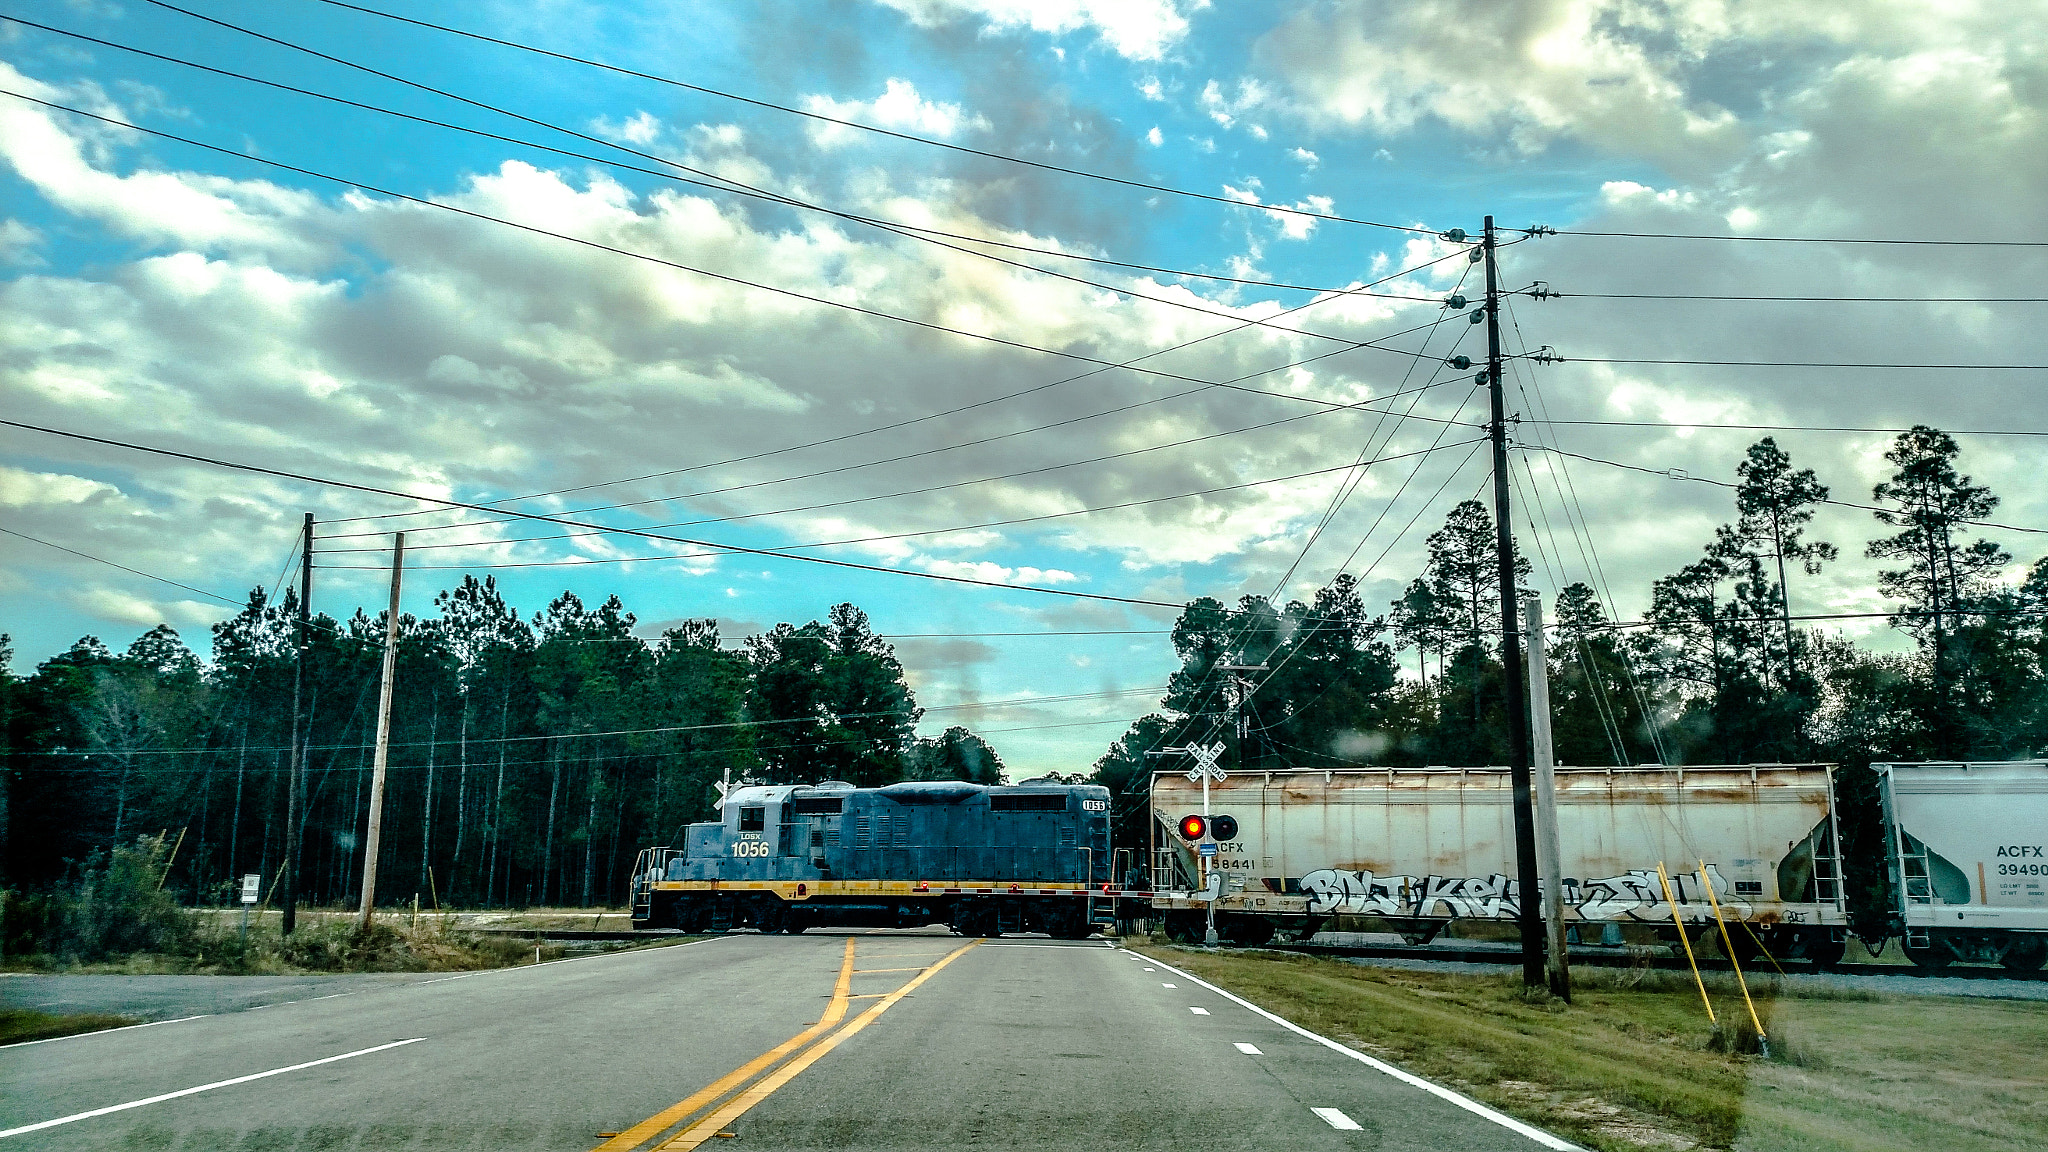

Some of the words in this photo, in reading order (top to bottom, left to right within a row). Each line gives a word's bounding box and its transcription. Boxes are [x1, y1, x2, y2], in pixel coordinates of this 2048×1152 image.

[1188, 744, 1203, 761] RAIL
[1208, 763, 1225, 780] ROAD
[1190, 743, 1224, 779] CROSSING
[1084, 801, 1104, 810] 1056
[731, 841, 769, 858] 1056
[1997, 845, 2043, 857] ACFX
[1998, 864, 2048, 876] 39490
